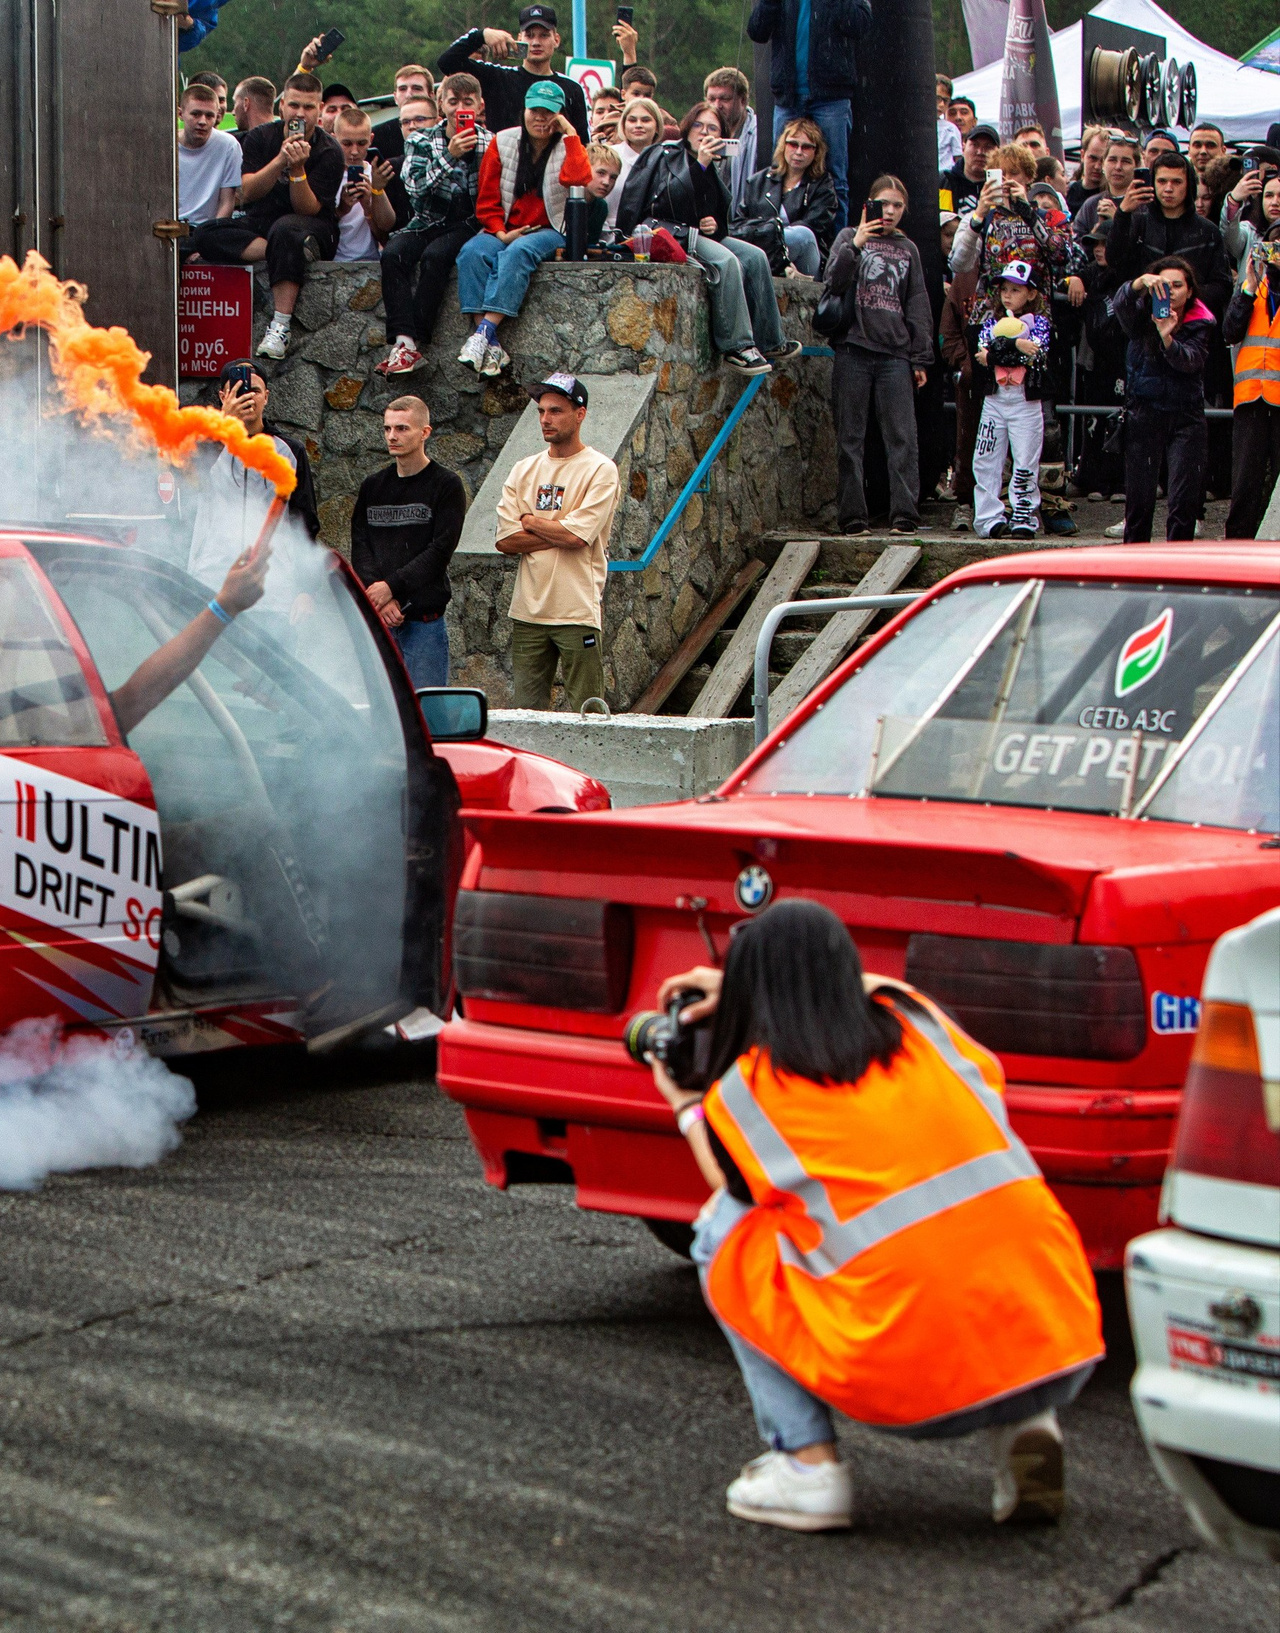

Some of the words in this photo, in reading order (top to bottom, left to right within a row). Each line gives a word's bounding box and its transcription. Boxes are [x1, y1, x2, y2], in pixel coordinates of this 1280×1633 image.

[194, 338, 229, 358] руб.
[181, 362, 188, 372] и
[191, 360, 218, 372] МЧС
[1078, 706, 1129, 729] СЕТЬ
[1131, 709, 1177, 732] АЗС
[993, 734, 1076, 776] GET
[15, 852, 116, 929] DRIFT
